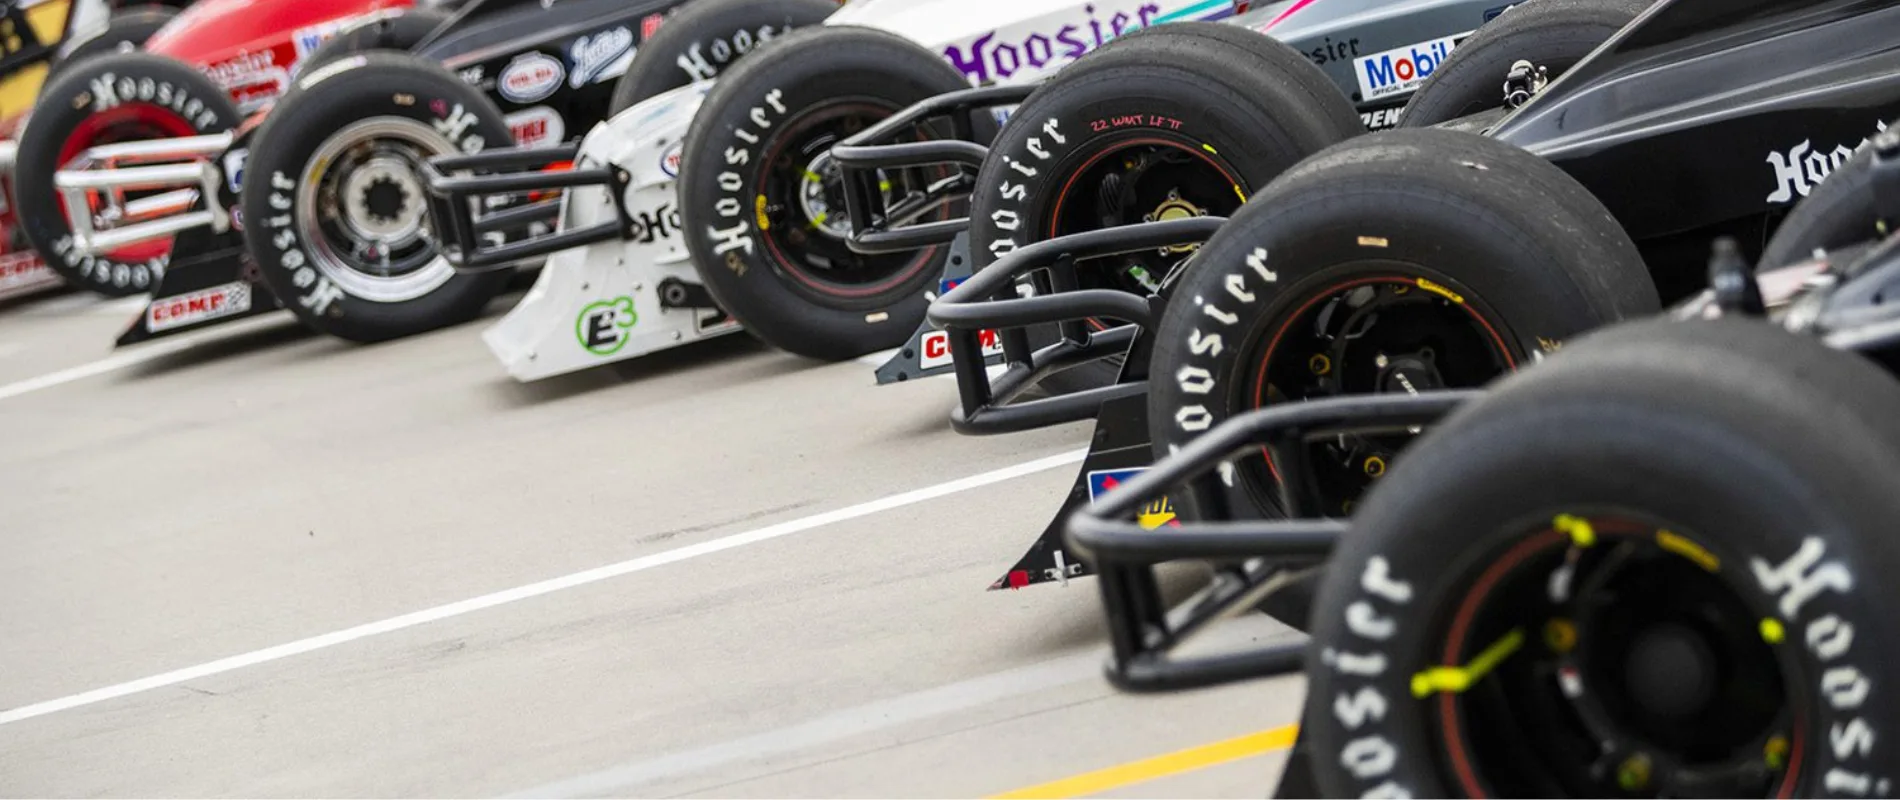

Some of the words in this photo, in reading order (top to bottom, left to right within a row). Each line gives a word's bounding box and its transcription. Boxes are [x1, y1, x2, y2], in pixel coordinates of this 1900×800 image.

[676, 15, 792, 84] Hoos
[945, 2, 1160, 83] Hoosier
[1364, 41, 1448, 89] Mobil
[90, 72, 218, 131] Hoosier
[1090, 119, 1109, 131] 22
[1149, 115, 1165, 127] LF
[706, 88, 787, 255] Hoosier
[989, 118, 1066, 299] oosier
[255, 170, 345, 315] Hoosier
[153, 292, 225, 321] COMP
[1168, 247, 1278, 488] oosier
[1751, 536, 1890, 799] Hoosi
